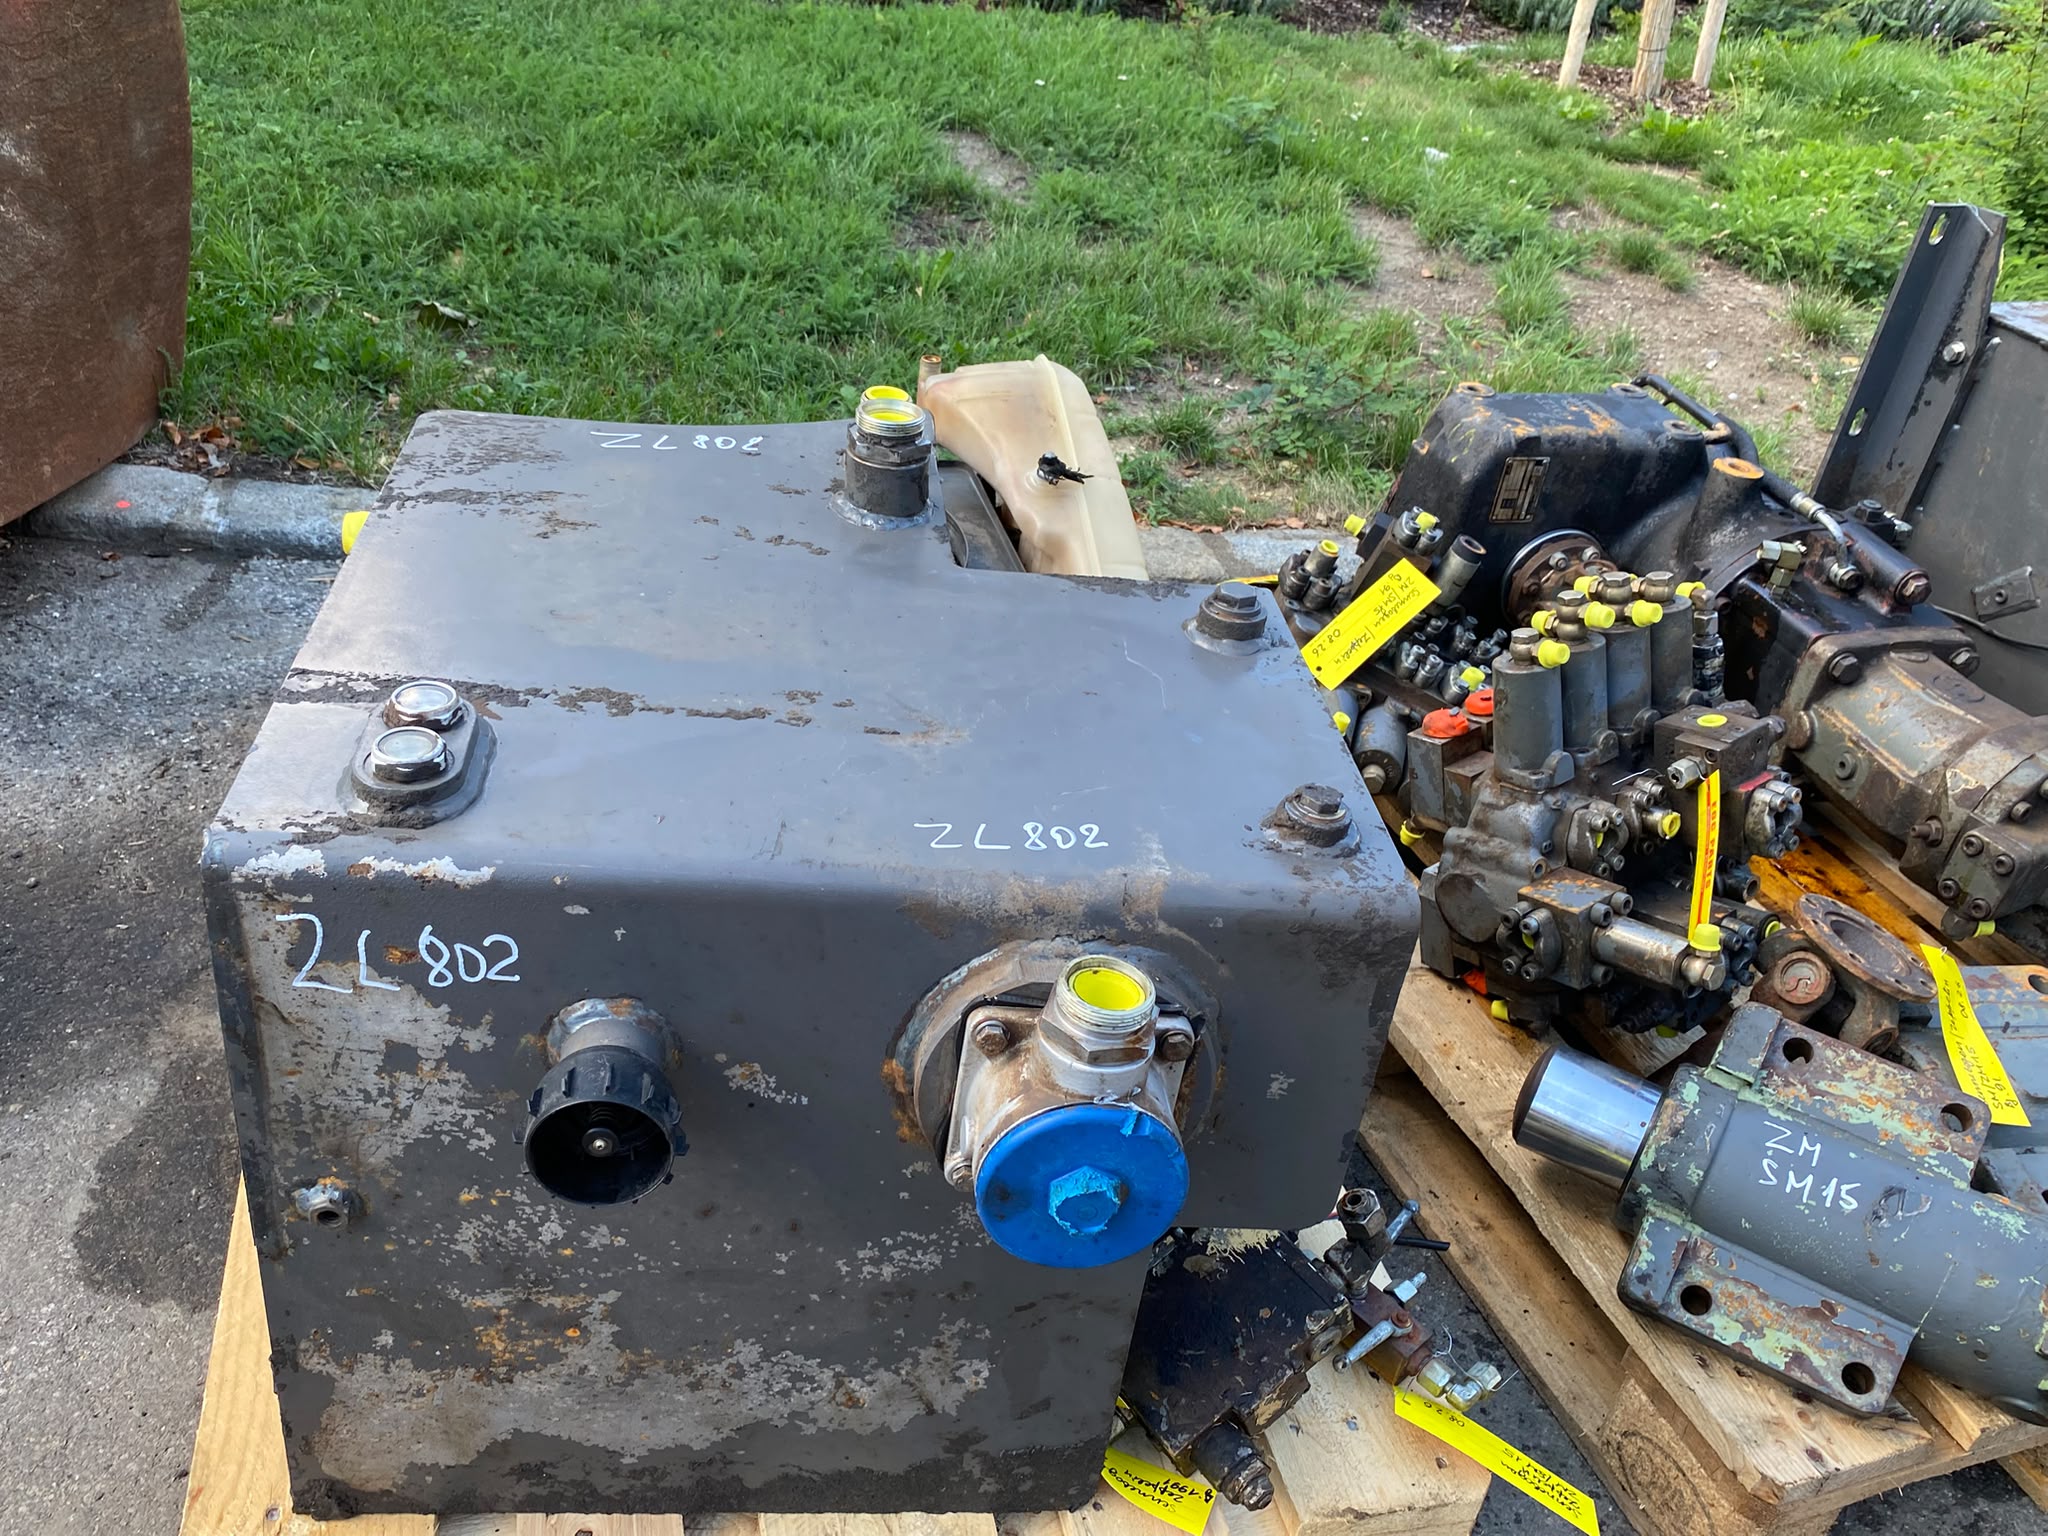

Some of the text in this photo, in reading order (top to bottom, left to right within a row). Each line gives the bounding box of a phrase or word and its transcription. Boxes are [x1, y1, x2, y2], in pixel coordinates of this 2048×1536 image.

[693, 434, 764, 451] 802
[1023, 822, 1109, 850] 802
[418, 924, 521, 988] 802
[1763, 1120, 1822, 1167] ZM
[1106, 1467, 1176, 1513] Sennebog
